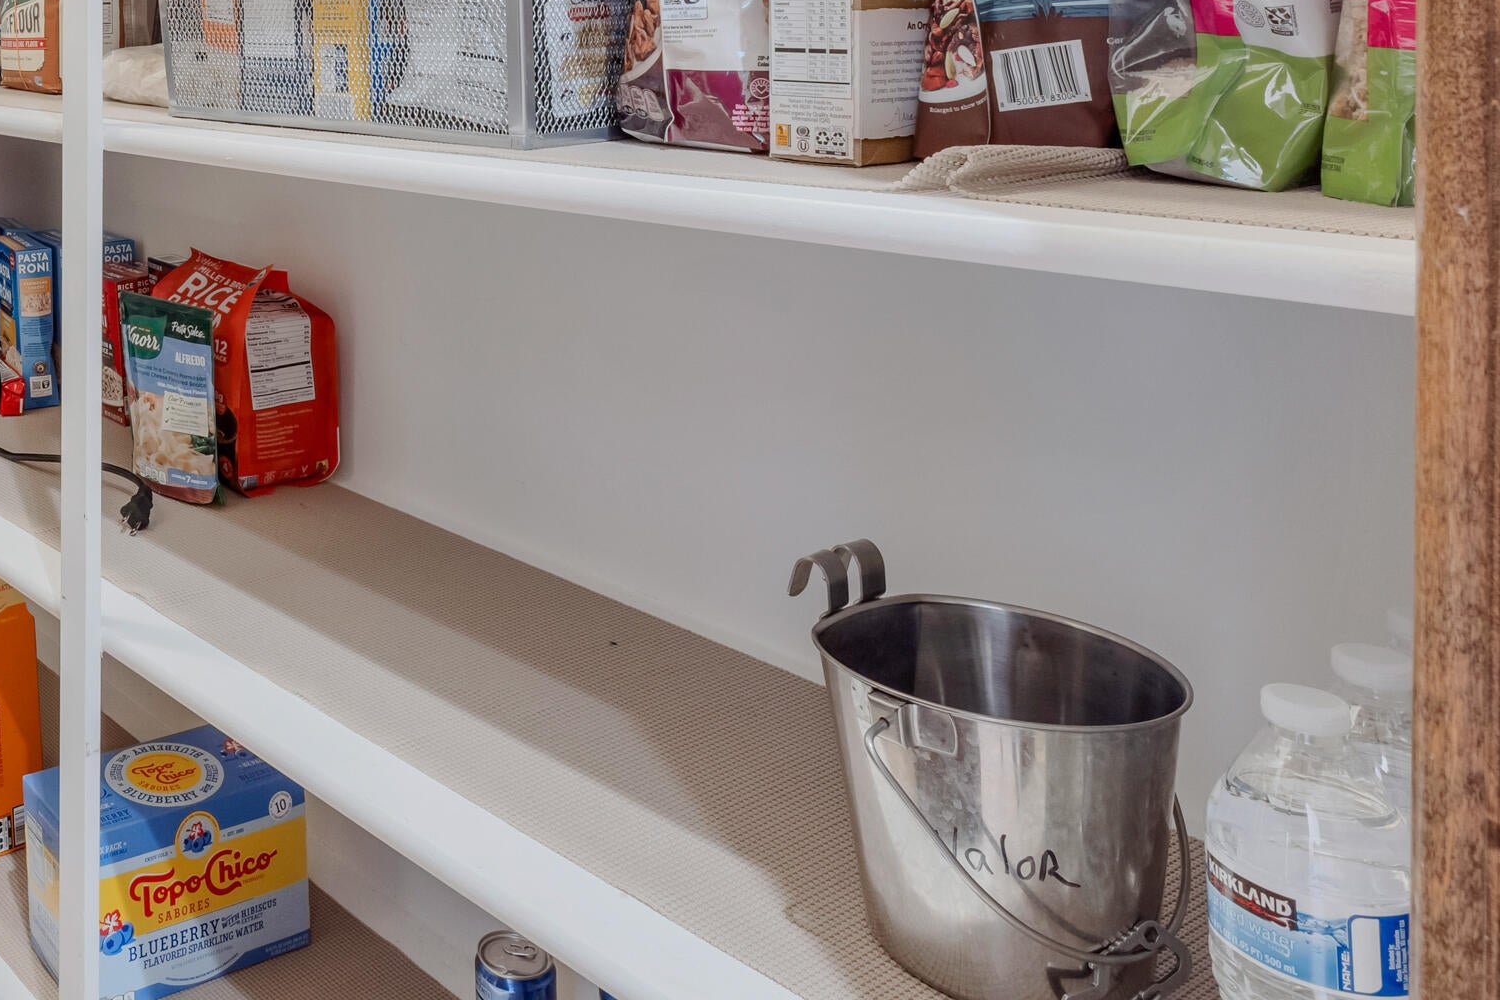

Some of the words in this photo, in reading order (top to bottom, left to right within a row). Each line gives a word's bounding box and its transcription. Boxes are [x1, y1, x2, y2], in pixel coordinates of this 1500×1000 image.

[9, 2, 40, 35] FOUR
[906, 21, 916, 30] An
[18, 251, 49, 263] PASTA
[104, 243, 132, 255] PASTA
[18, 261, 50, 275] RONI
[200, 266, 226, 283] MILLET
[117, 282, 134, 291] RICE
[176, 271, 243, 314] RICE
[127, 324, 160, 351] Knorr
[215, 339, 228, 356] 12
[175, 352, 205, 367] ALFREDO
[132, 744, 204, 759] BLUEBERRY
[131, 761, 176, 778] Topo
[155, 767, 197, 785] Chico
[122, 786, 200, 804] BLUEBERRY
[138, 780, 181, 792] SABORES
[274, 798, 287, 813] 10
[129, 866, 202, 918] Topo
[201, 848, 278, 896] Chico
[1208, 858, 1292, 916] KIRKLAND
[157, 897, 211, 925] SABORES
[128, 917, 220, 963] BLUEBERRY
[221, 915, 240, 930] WITH
[240, 898, 278, 918] HIBISCUS
[1249, 922, 1297, 951] water
[142, 948, 188, 970] FLAVORED
[187, 930, 235, 955] SPARKLING
[234, 920, 265, 939] WATER
[1263, 953, 1282, 970] 500
[1283, 962, 1300, 977] mL
[1342, 950, 1351, 991] NAME:
